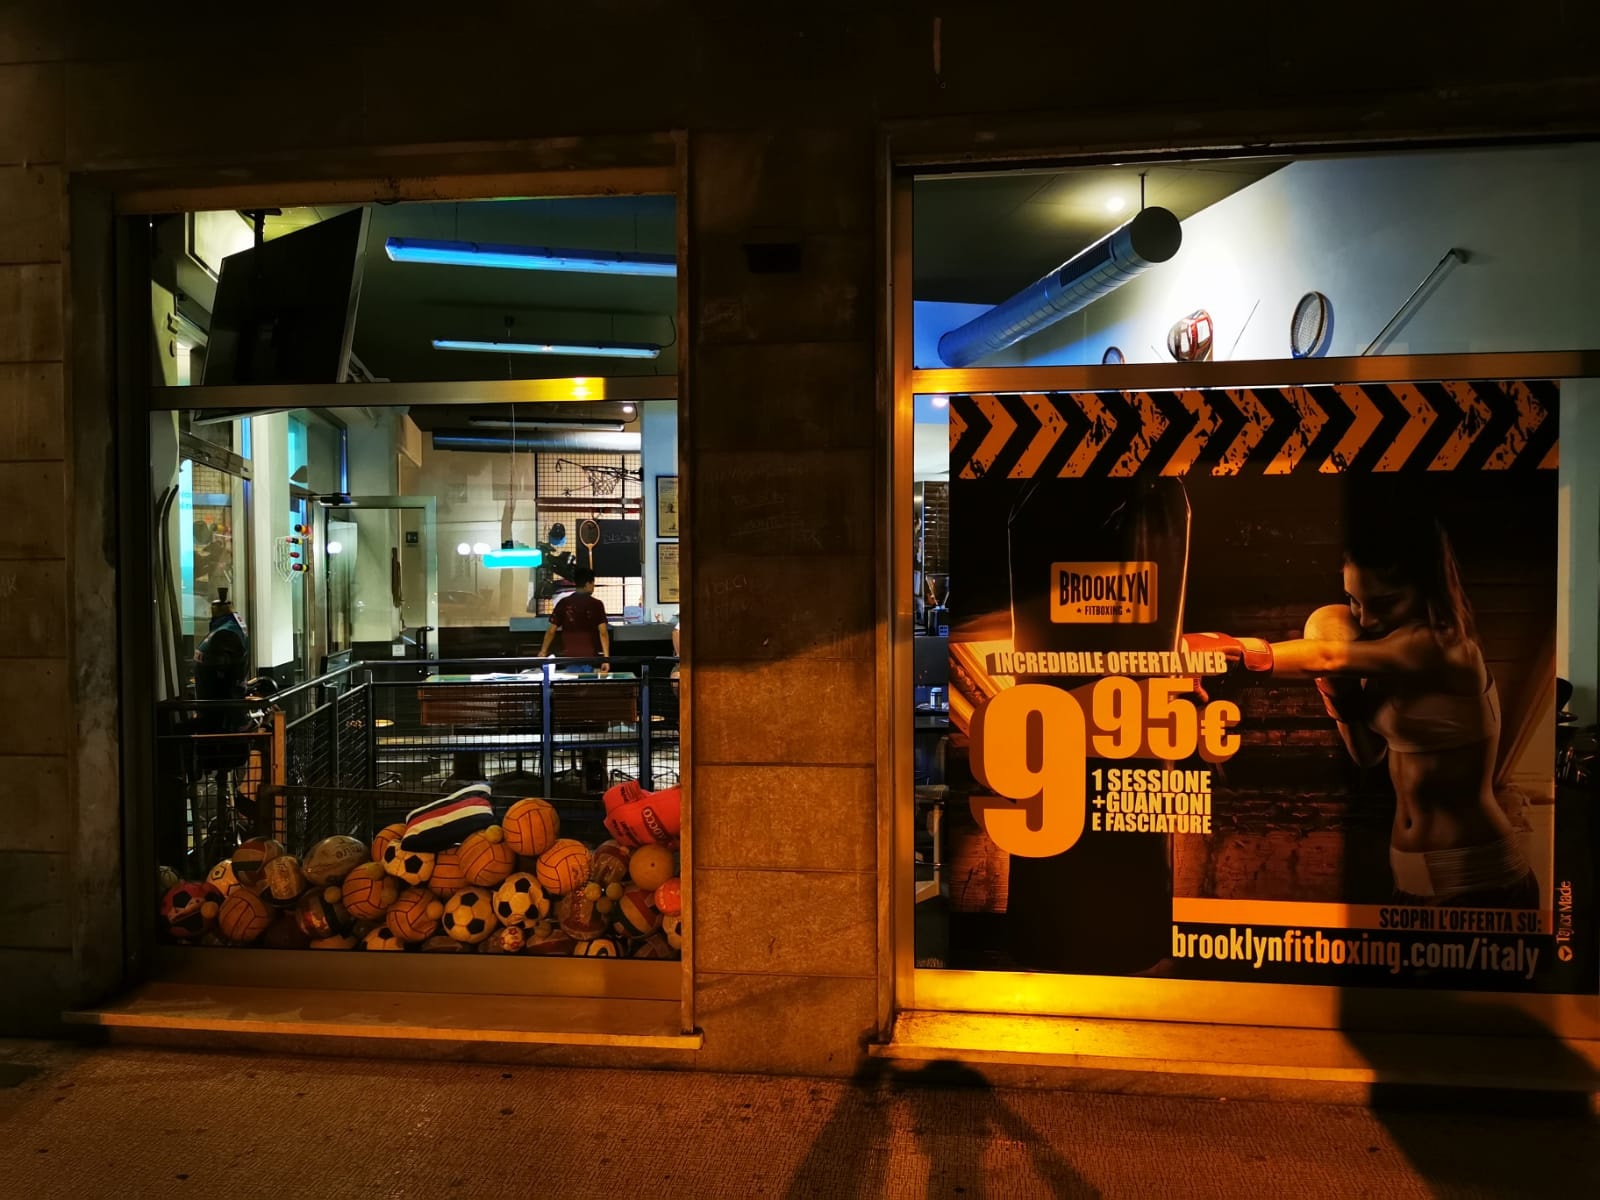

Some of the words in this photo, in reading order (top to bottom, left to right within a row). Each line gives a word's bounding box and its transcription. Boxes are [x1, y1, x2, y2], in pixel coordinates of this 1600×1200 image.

[1059, 570, 1149, 606] BROOKLYN
[1084, 605, 1123, 616] FITBOXING
[994, 651, 1105, 674] INCREDIBILE
[1107, 651, 1180, 674] OFFERTA
[1182, 651, 1228, 674] WEB
[1092, 769, 1102, 791] 1
[1107, 769, 1212, 793] SESSIONE
[1092, 813, 1101, 832] E
[1105, 813, 1212, 834] FASCIATURE
[1558, 880, 1574, 912] Made
[1379, 907, 1435, 930] SCOPRI
[1439, 909, 1513, 932] L'OFFERTA
[1517, 911, 1543, 933] SU:
[1172, 925, 1540, 980] brooklynfitboxing.com/italy
